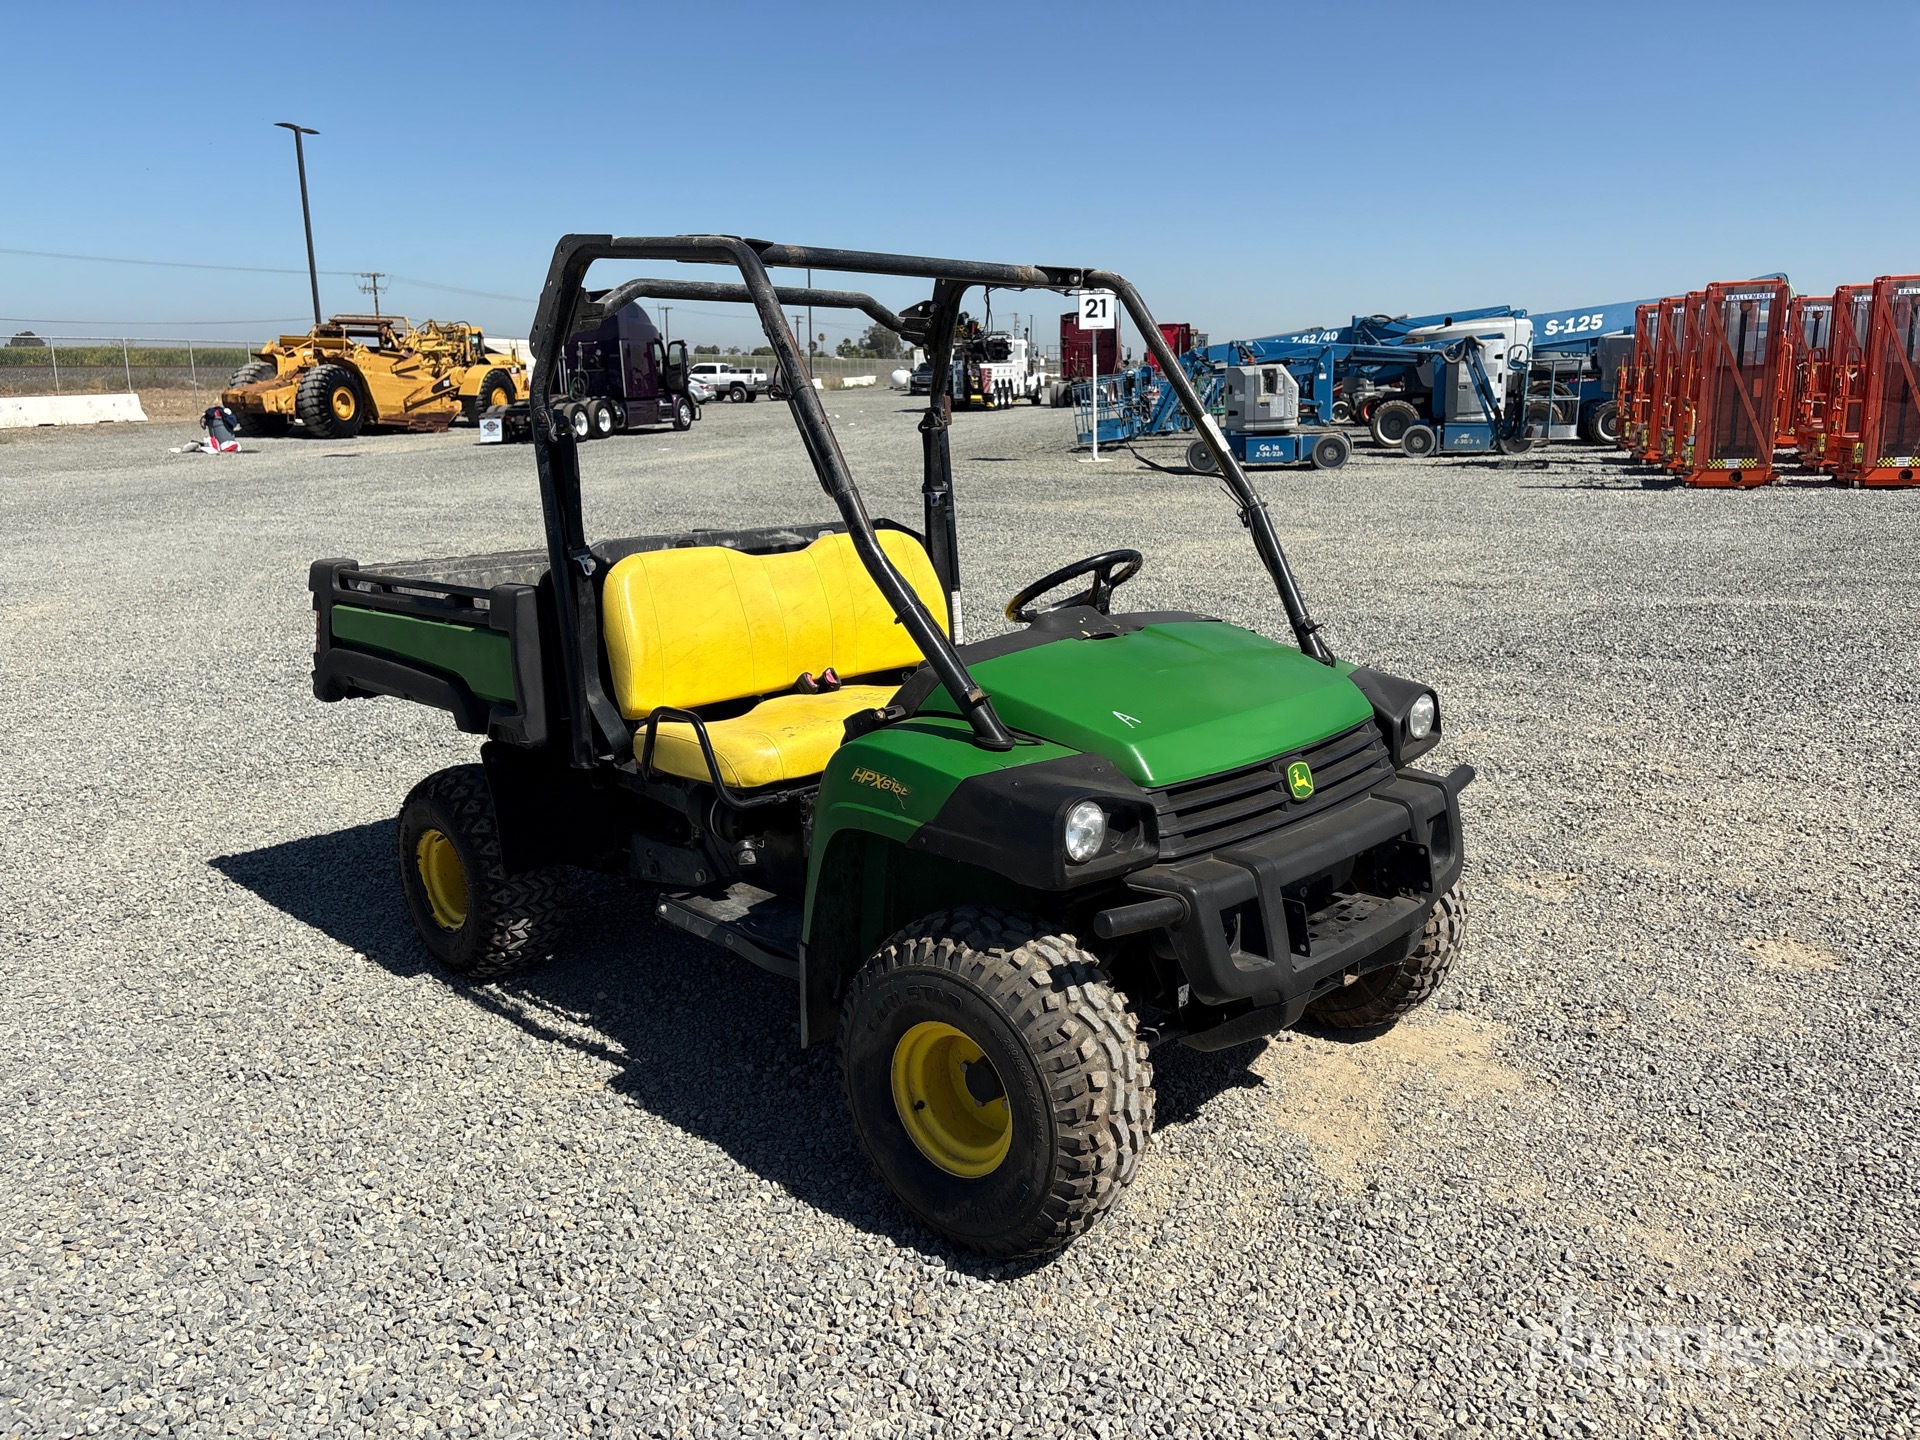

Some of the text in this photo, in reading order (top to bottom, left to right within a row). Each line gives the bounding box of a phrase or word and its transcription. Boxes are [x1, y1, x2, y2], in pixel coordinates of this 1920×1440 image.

[1727, 292, 1772, 301] BALLYMORE
[1085, 298, 1107, 318] 21
[1544, 313, 1604, 336] S-125
[1291, 330, 1339, 344] Z-62/40
[1112, 710, 1142, 729] A
